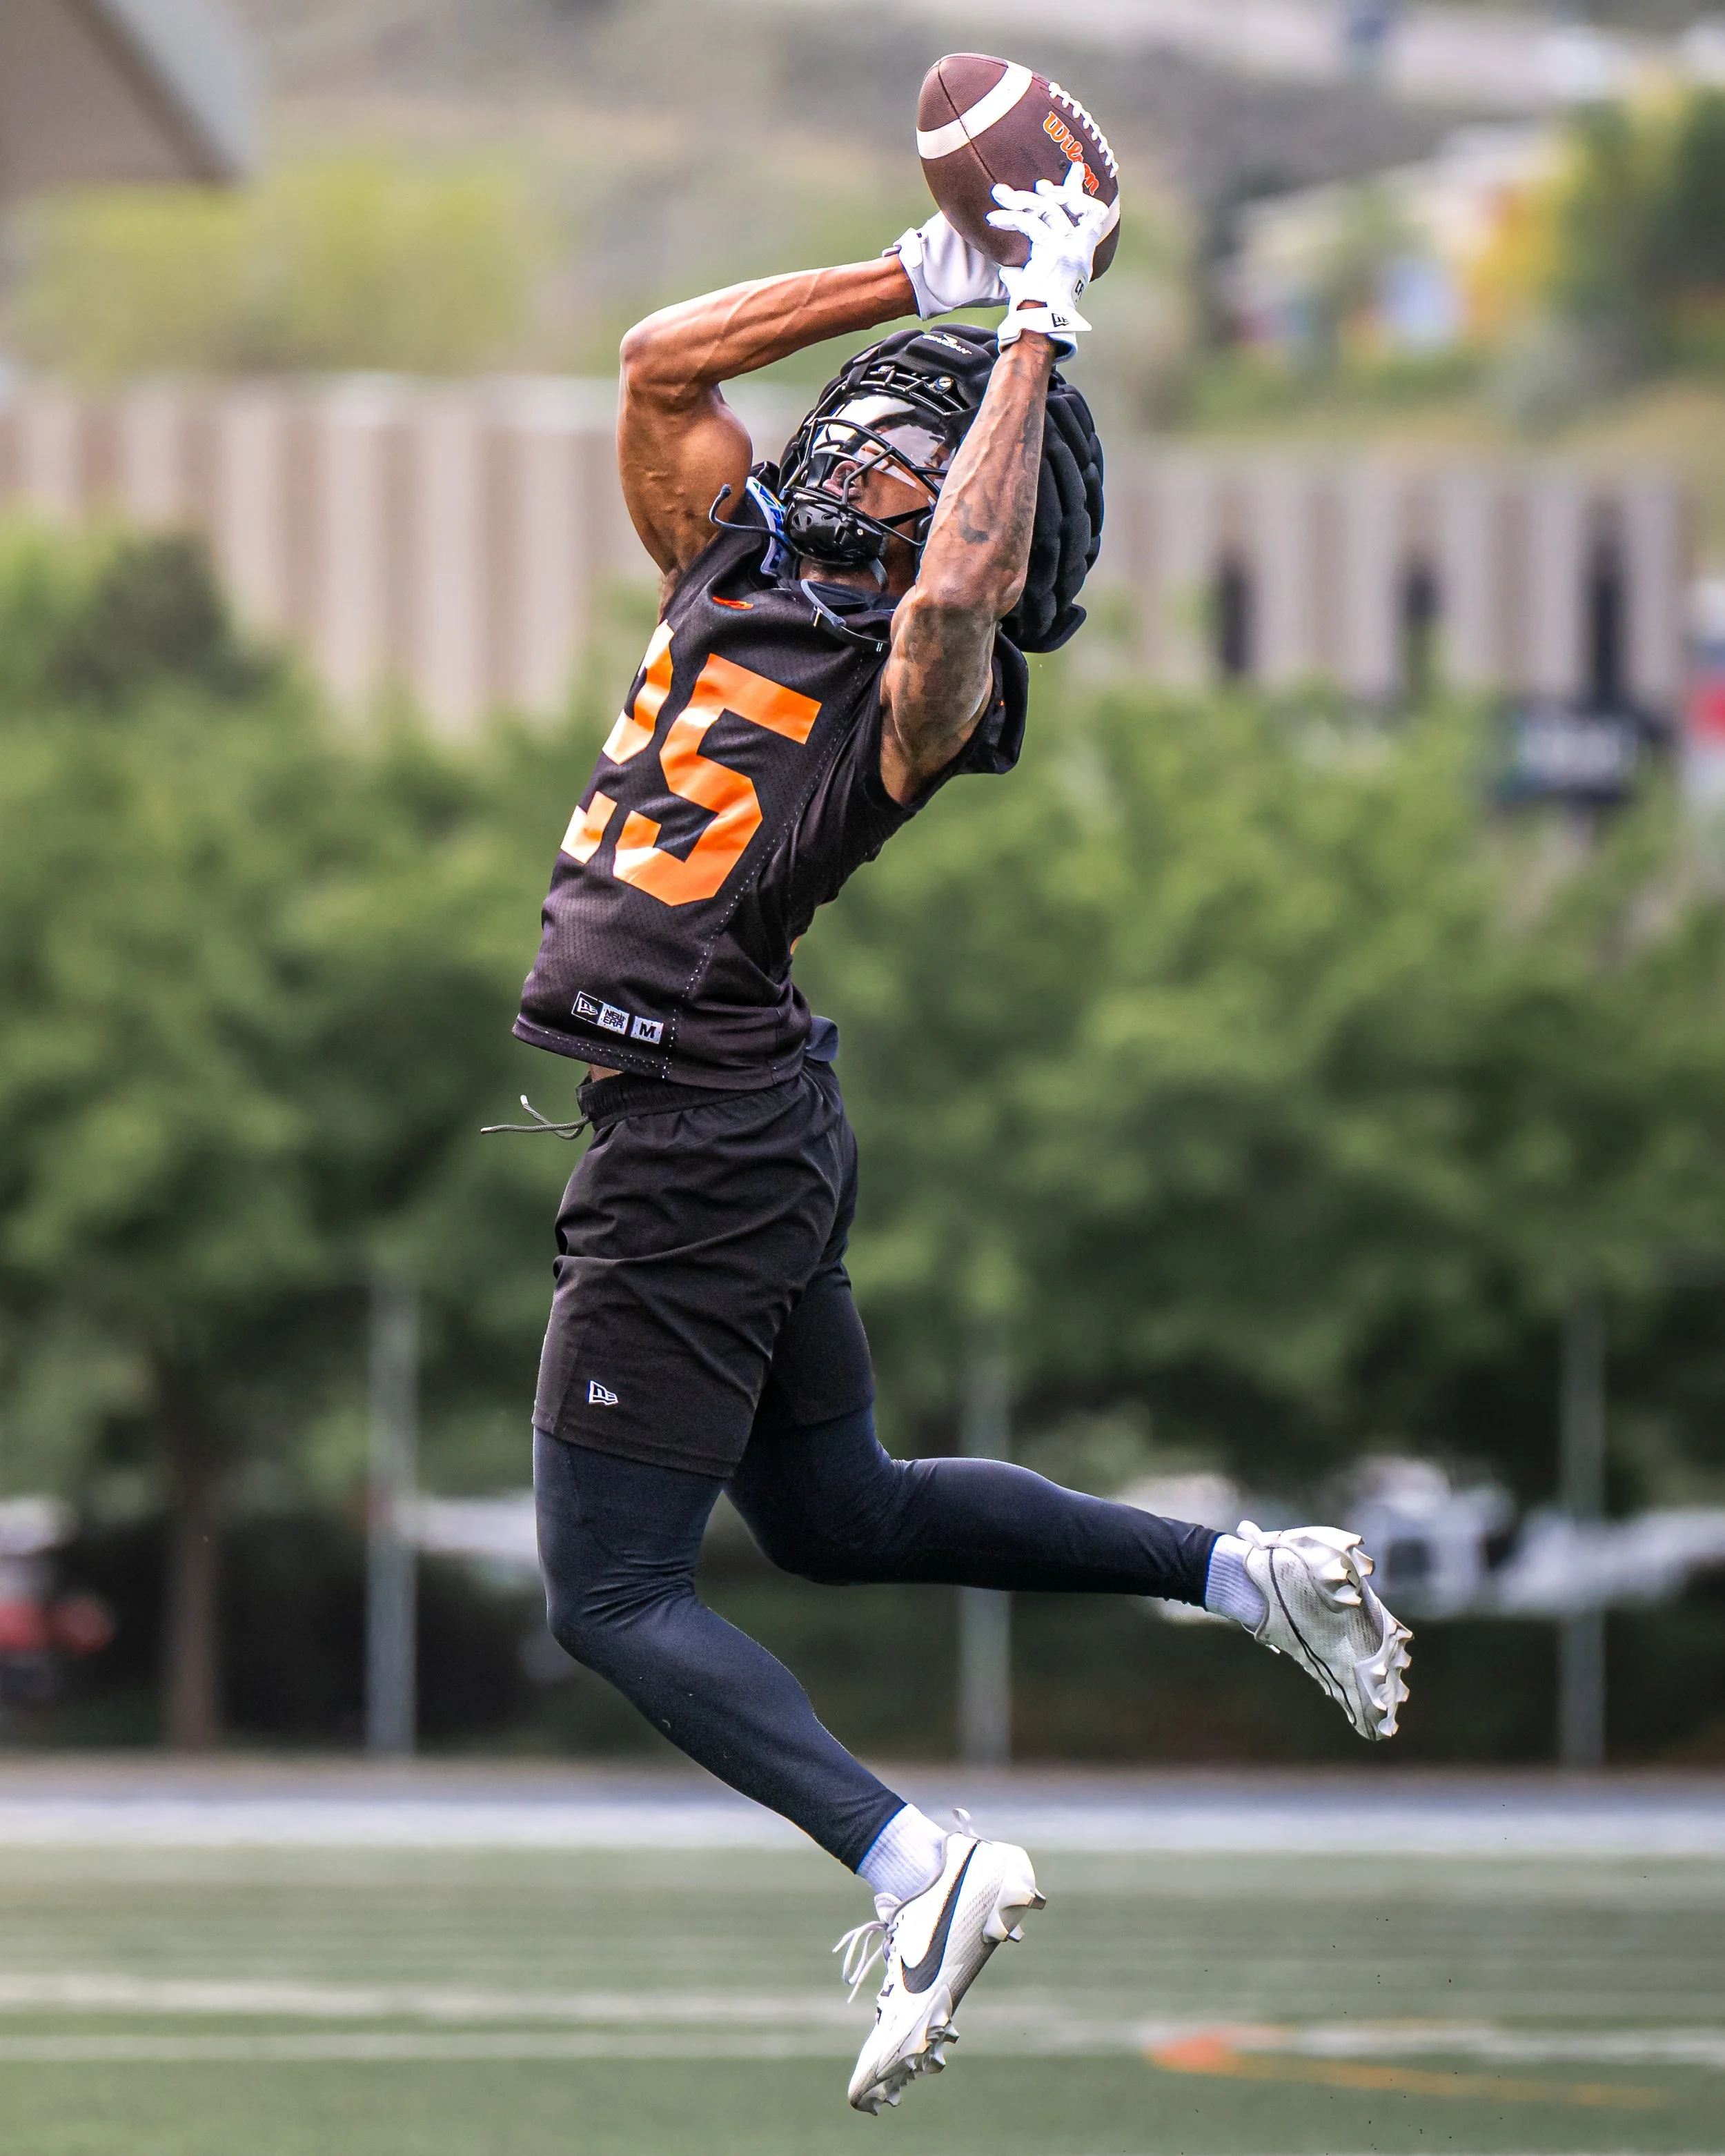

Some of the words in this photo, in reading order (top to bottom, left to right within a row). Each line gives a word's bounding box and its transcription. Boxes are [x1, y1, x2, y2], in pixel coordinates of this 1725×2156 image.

[604, 1009, 626, 1022] NEW
[602, 1017, 624, 1029] ERA
[639, 1021, 657, 1039] M
